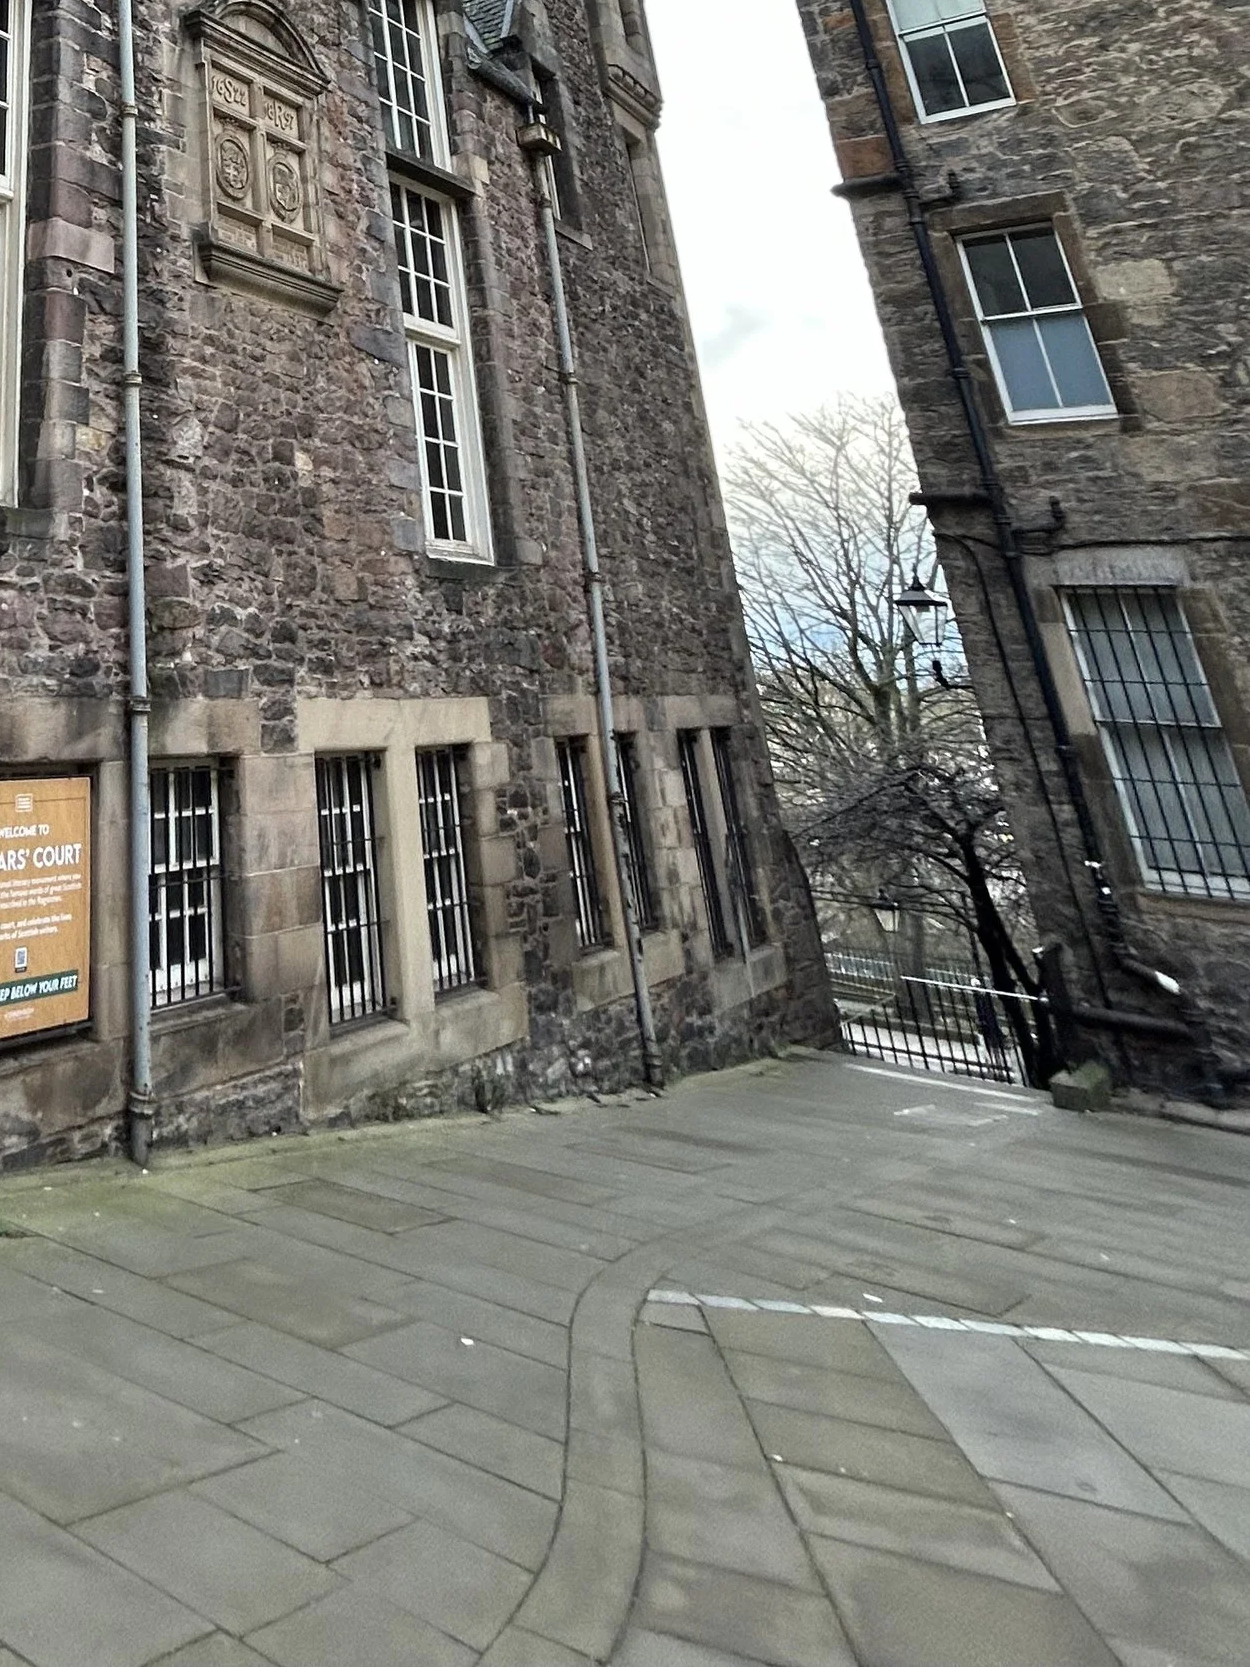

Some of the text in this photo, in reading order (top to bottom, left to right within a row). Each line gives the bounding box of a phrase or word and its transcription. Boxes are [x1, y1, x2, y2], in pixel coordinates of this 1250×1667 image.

[38, 823, 50, 836] TO
[32, 843, 82, 869] COURT
[10, 982, 38, 1000] BELOW
[38, 977, 59, 994] YOUR
[59, 974, 78, 990] FEET
